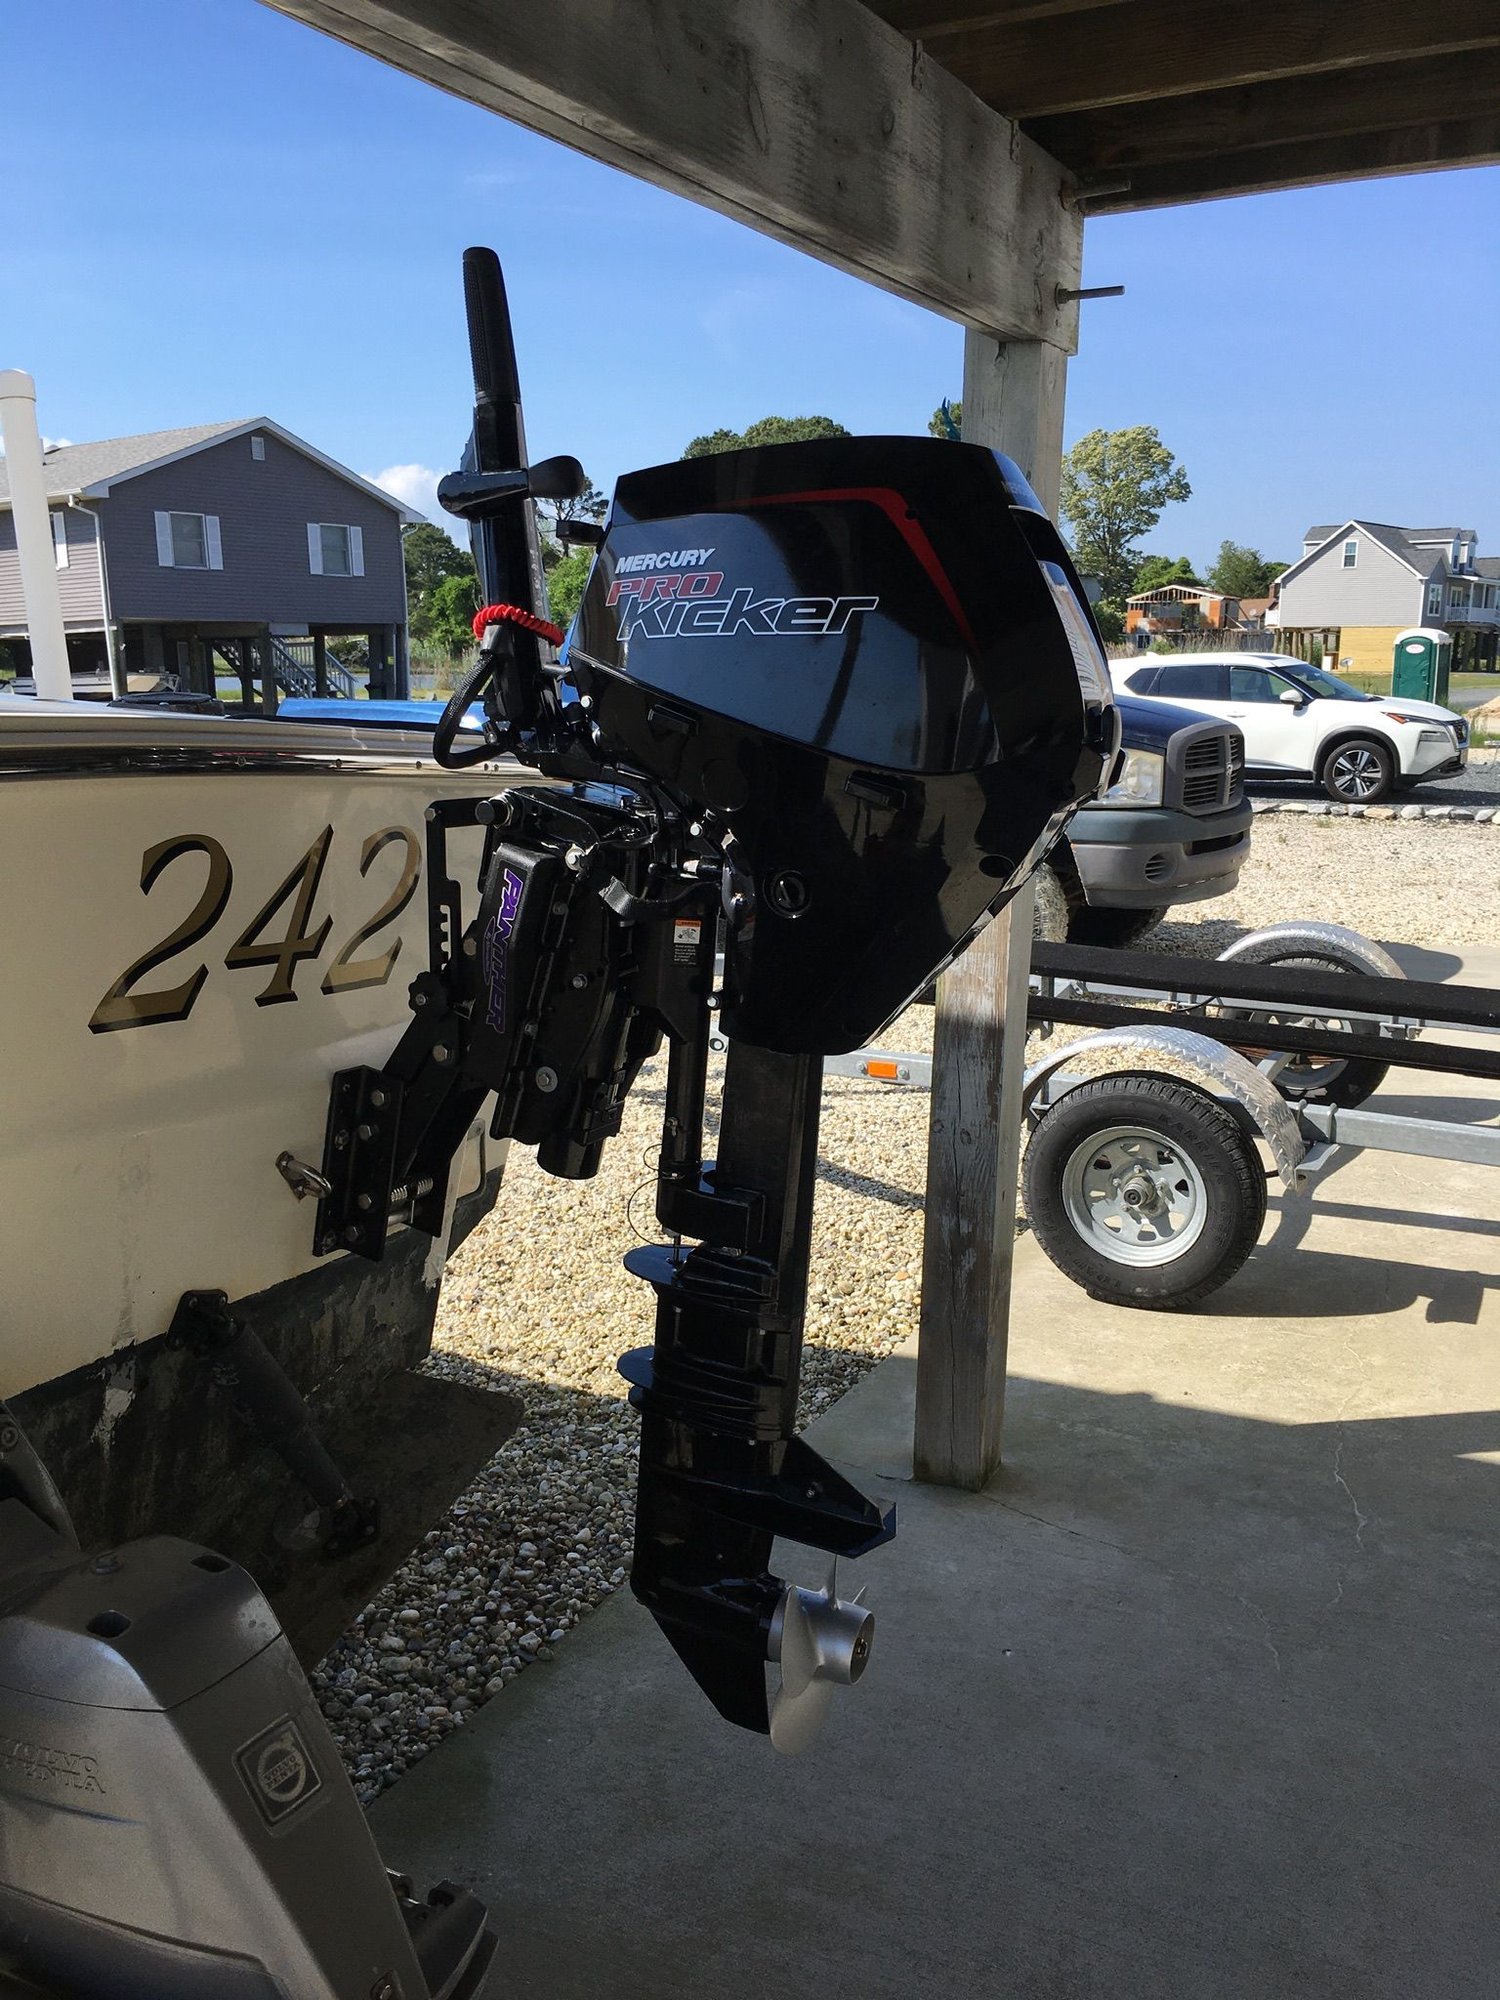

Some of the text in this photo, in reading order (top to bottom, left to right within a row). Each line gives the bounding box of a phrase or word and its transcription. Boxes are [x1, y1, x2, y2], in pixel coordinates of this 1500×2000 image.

[615, 548, 715, 575] MERCURY
[605, 571, 724, 607] PRO
[87, 824, 423, 1034] 242
[486, 868, 524, 1034] PANTHER
[263, 1754, 297, 1780] VOLVO
